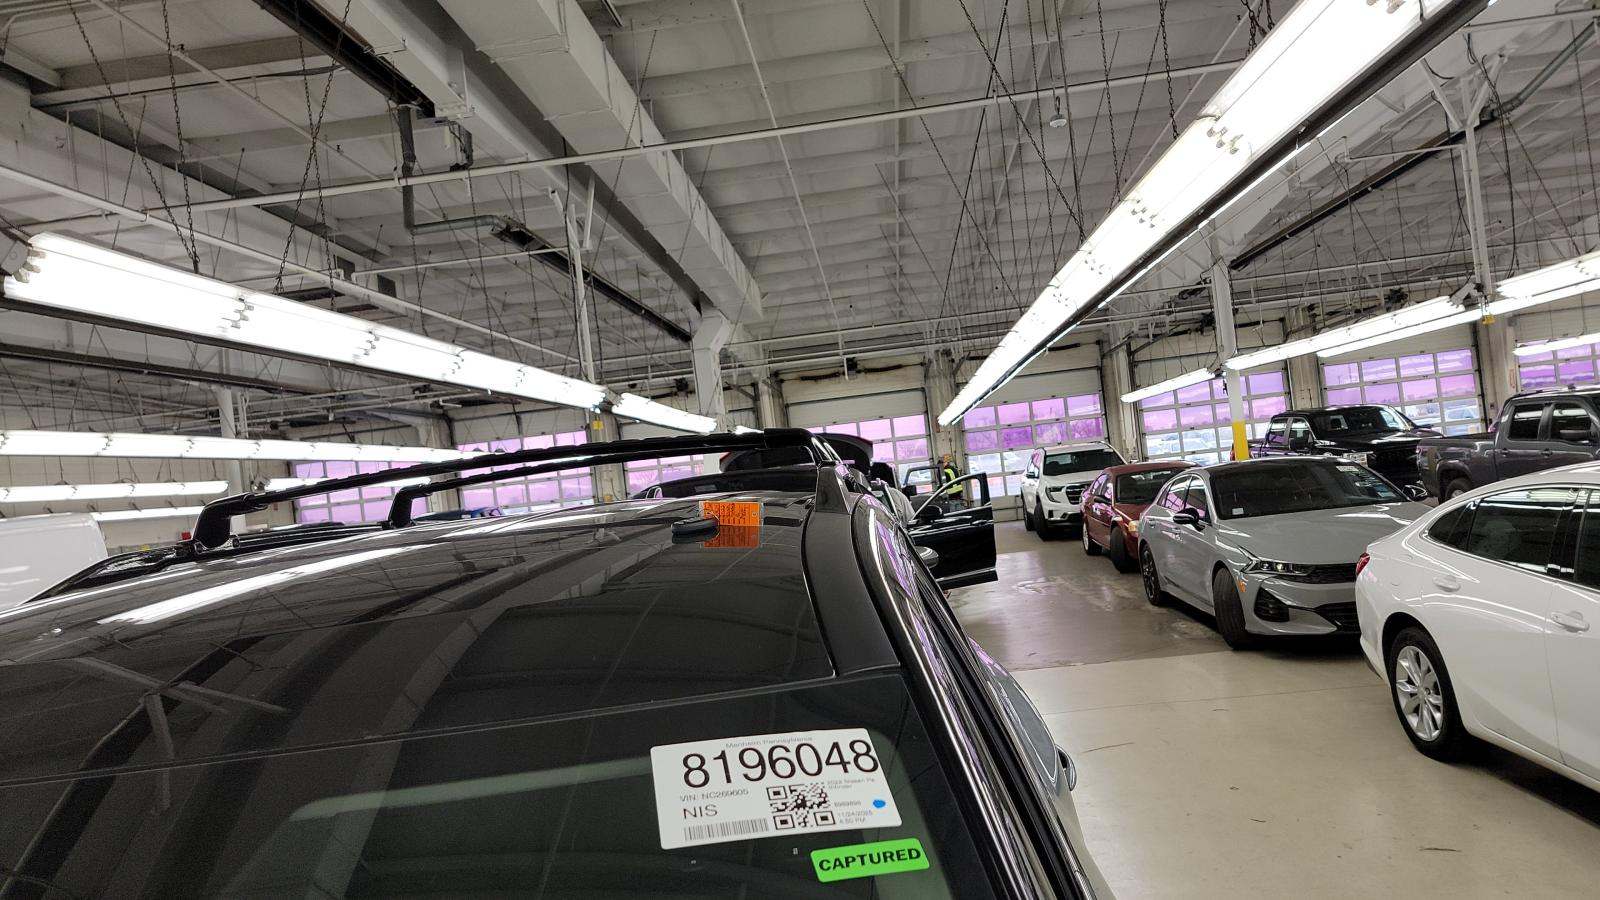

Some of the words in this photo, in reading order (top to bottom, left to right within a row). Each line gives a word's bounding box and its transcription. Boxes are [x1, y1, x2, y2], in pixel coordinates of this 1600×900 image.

[682, 739, 879, 788] 8196048
[683, 804, 718, 819] NIS
[818, 848, 921, 871] CAPTURED
